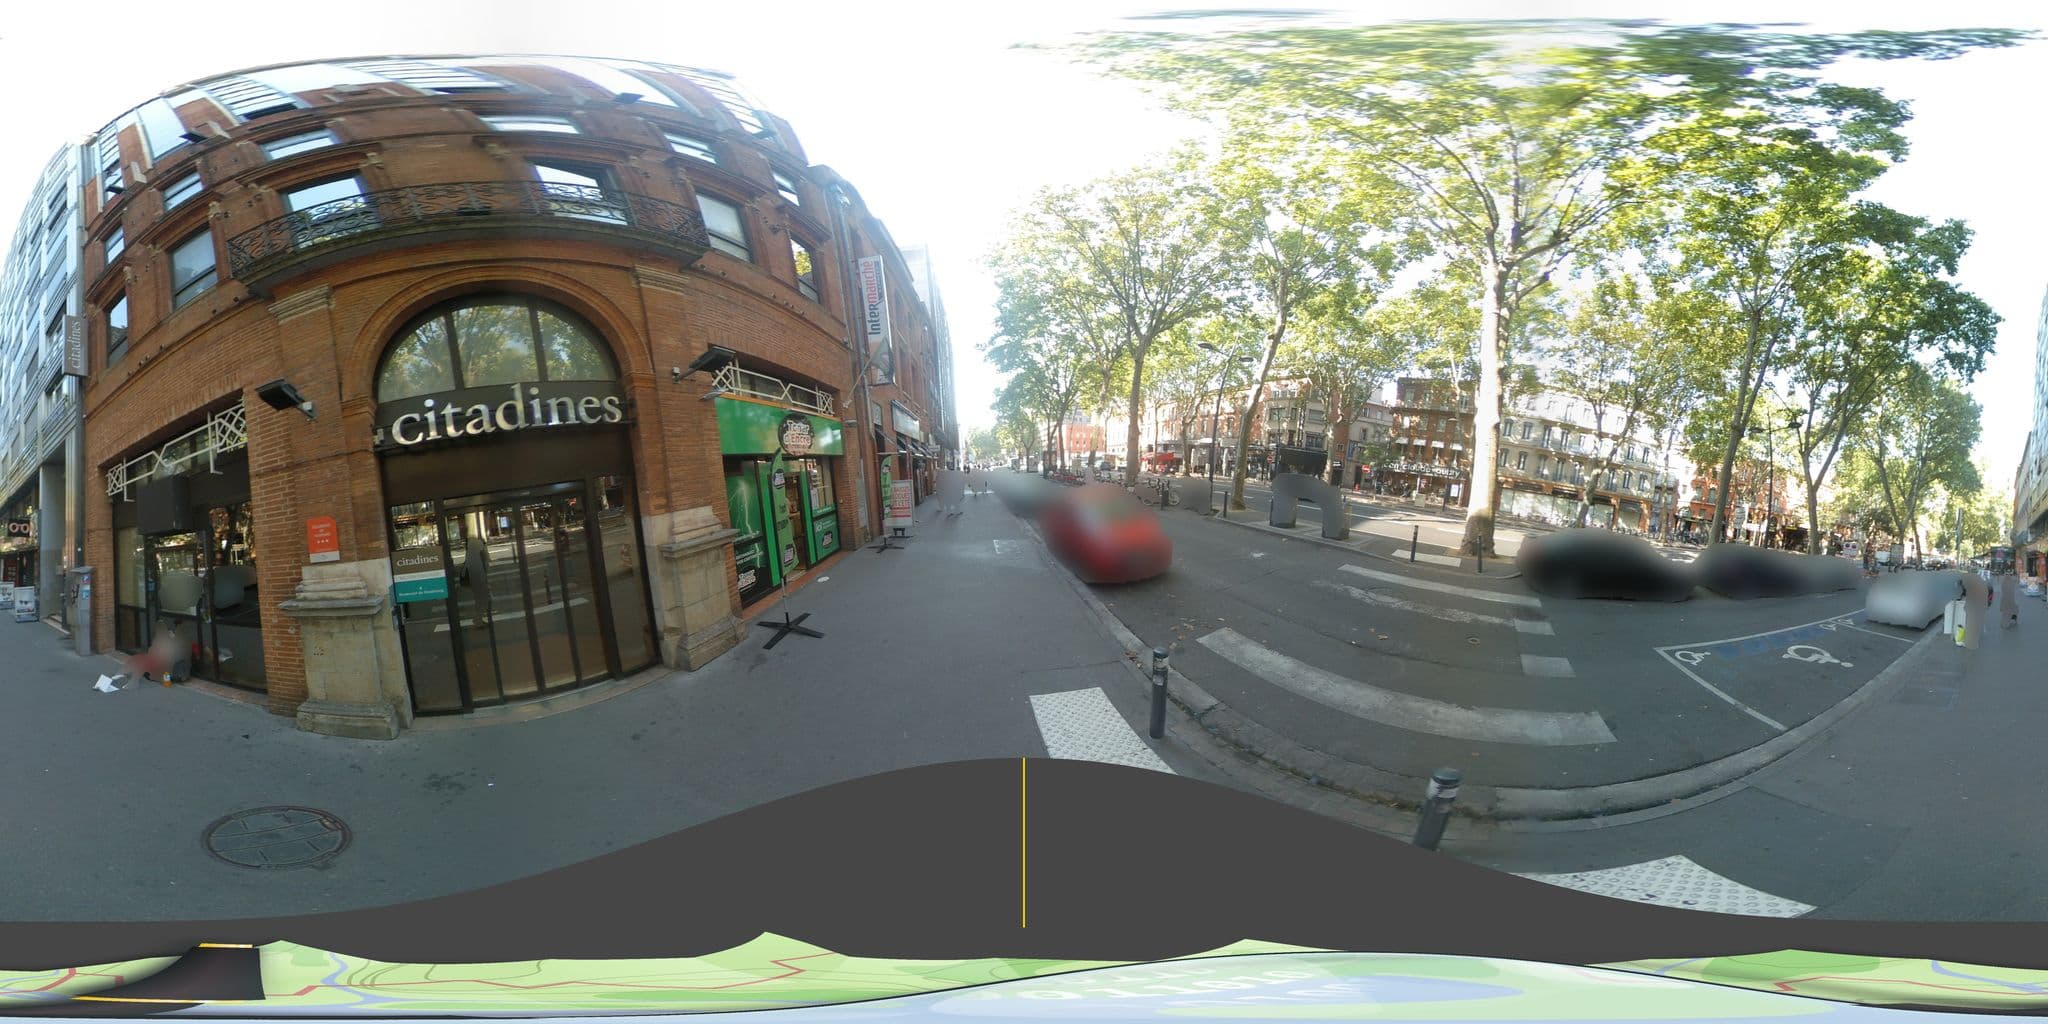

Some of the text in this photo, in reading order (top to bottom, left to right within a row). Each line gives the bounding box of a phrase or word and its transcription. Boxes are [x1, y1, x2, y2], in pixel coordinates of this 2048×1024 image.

[67, 320, 81, 369] citadines
[391, 383, 623, 446] citadines
[396, 554, 440, 567] citadines
